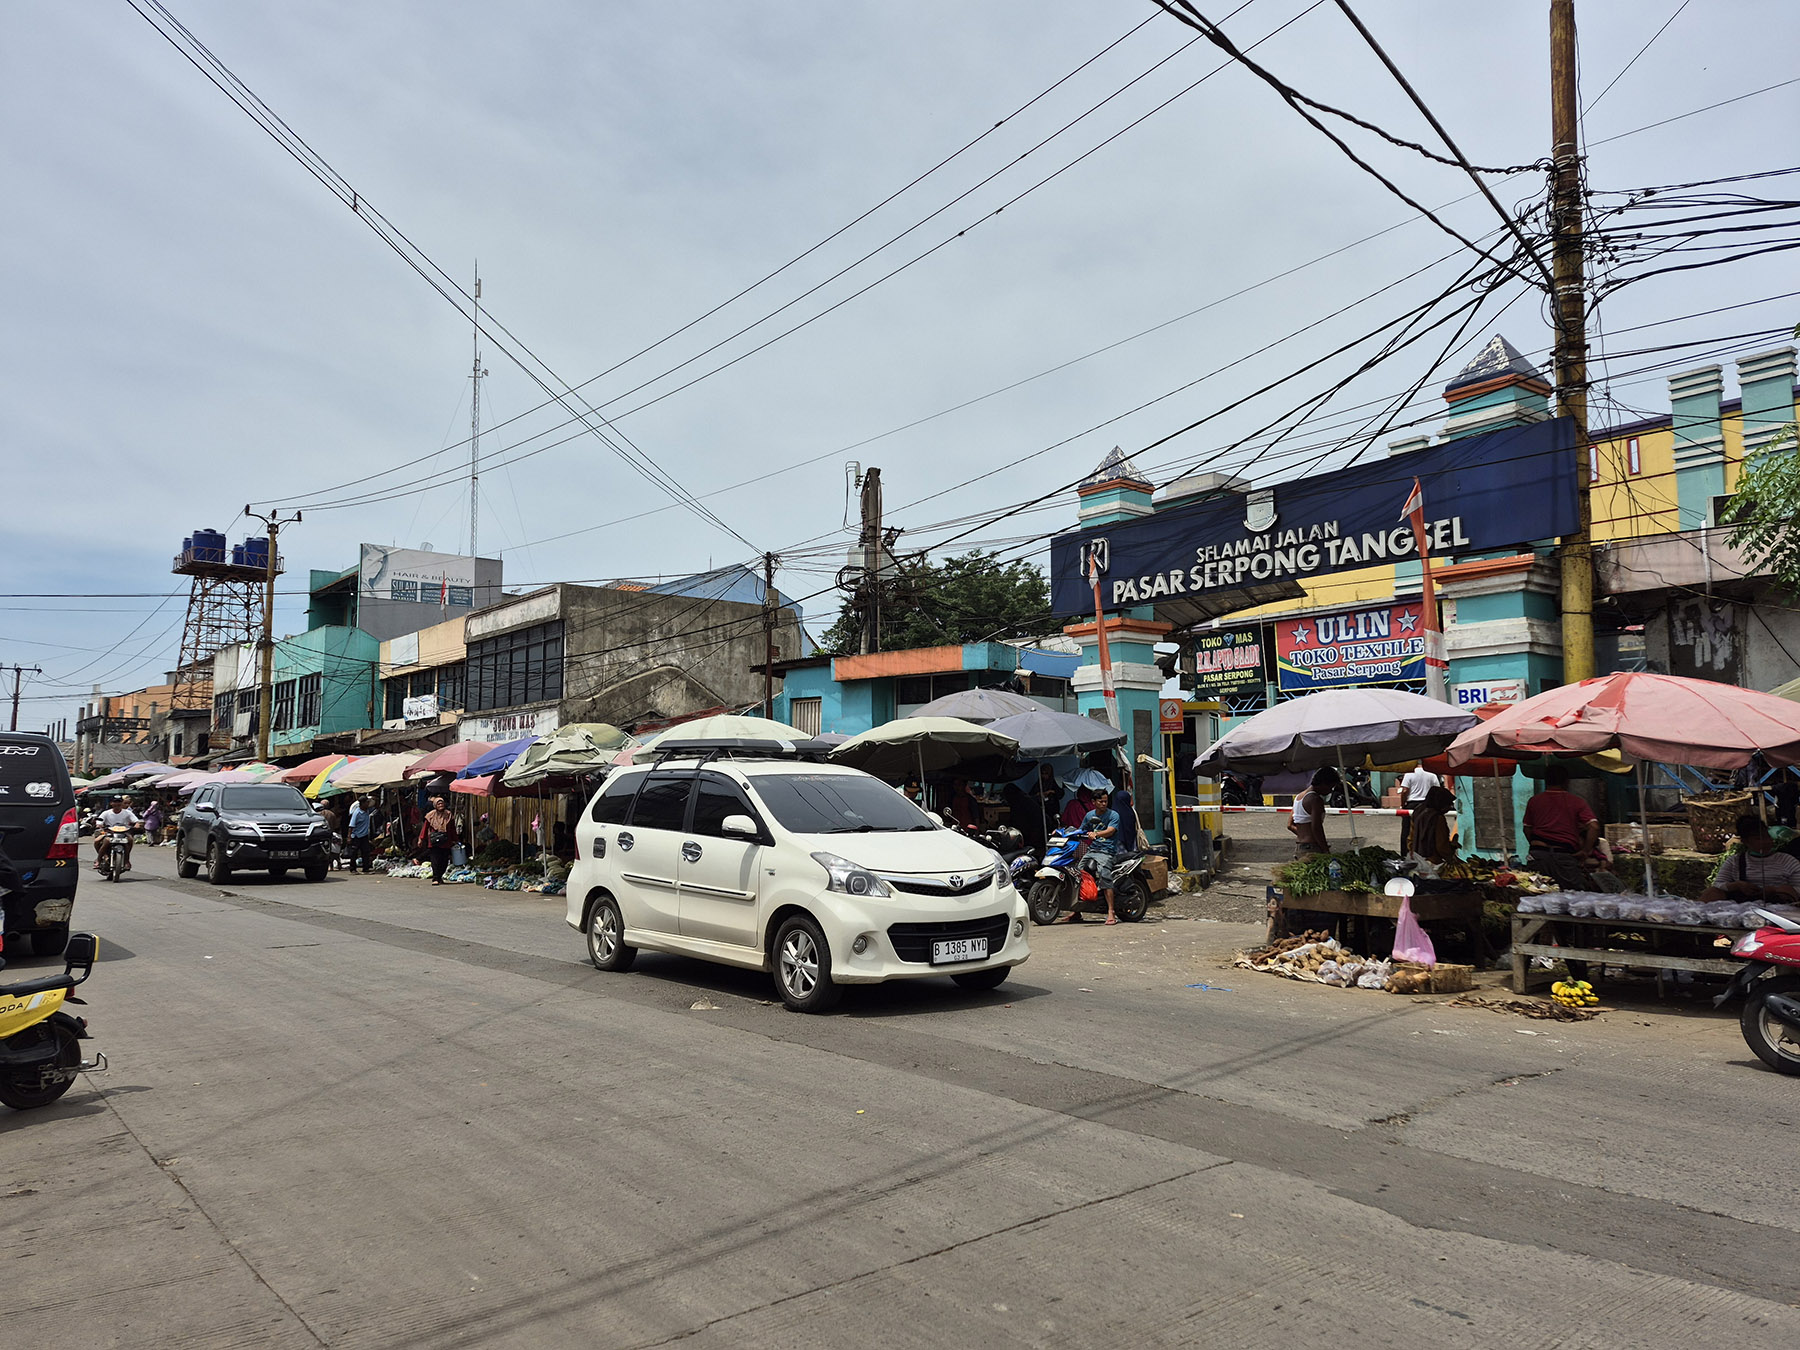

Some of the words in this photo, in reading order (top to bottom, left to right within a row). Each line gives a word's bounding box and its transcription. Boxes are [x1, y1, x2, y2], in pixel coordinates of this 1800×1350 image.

[1196, 534, 1271, 563] SELAMAT
[1274, 520, 1339, 548] JALAN
[1113, 569, 1187, 604] PASAR
[1189, 544, 1321, 591] SERPONG
[1324, 516, 1470, 566] TANGSEL
[393, 571, 418, 579] HAIR
[1315, 610, 1390, 645] ULIN
[1201, 637, 1222, 648] TOKO
[1235, 632, 1253, 644] MAS
[1290, 648, 1339, 667] TOKO
[1340, 637, 1424, 662] TEXTILE
[1203, 673, 1223, 682] PASAR
[1223, 669, 1254, 681] SERPONG
[1312, 666, 1346, 680] Pasar
[1347, 661, 1401, 678] Serpong
[1458, 688, 1487, 704] BRI
[934, 943, 941, 956] B
[945, 940, 967, 955] 1385
[971, 938, 987, 952] NYD
